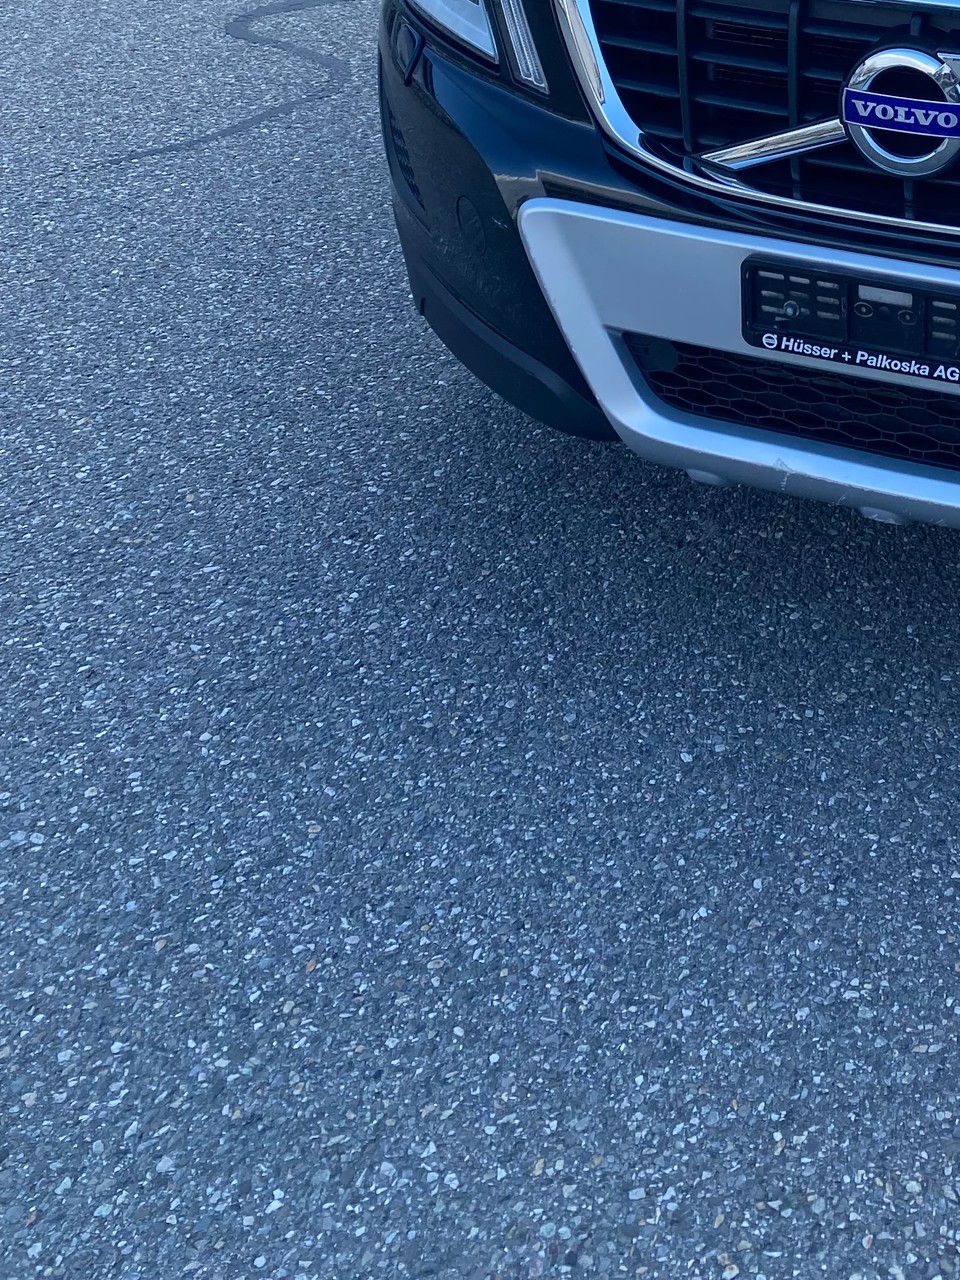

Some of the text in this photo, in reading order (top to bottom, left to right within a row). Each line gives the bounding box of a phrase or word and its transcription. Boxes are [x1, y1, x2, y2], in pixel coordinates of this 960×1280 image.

[851, 99, 958, 128] VOLVO
[781, 336, 838, 359] Hüsser
[855, 350, 930, 376] Palkoska
[933, 364, 960, 381] AG
